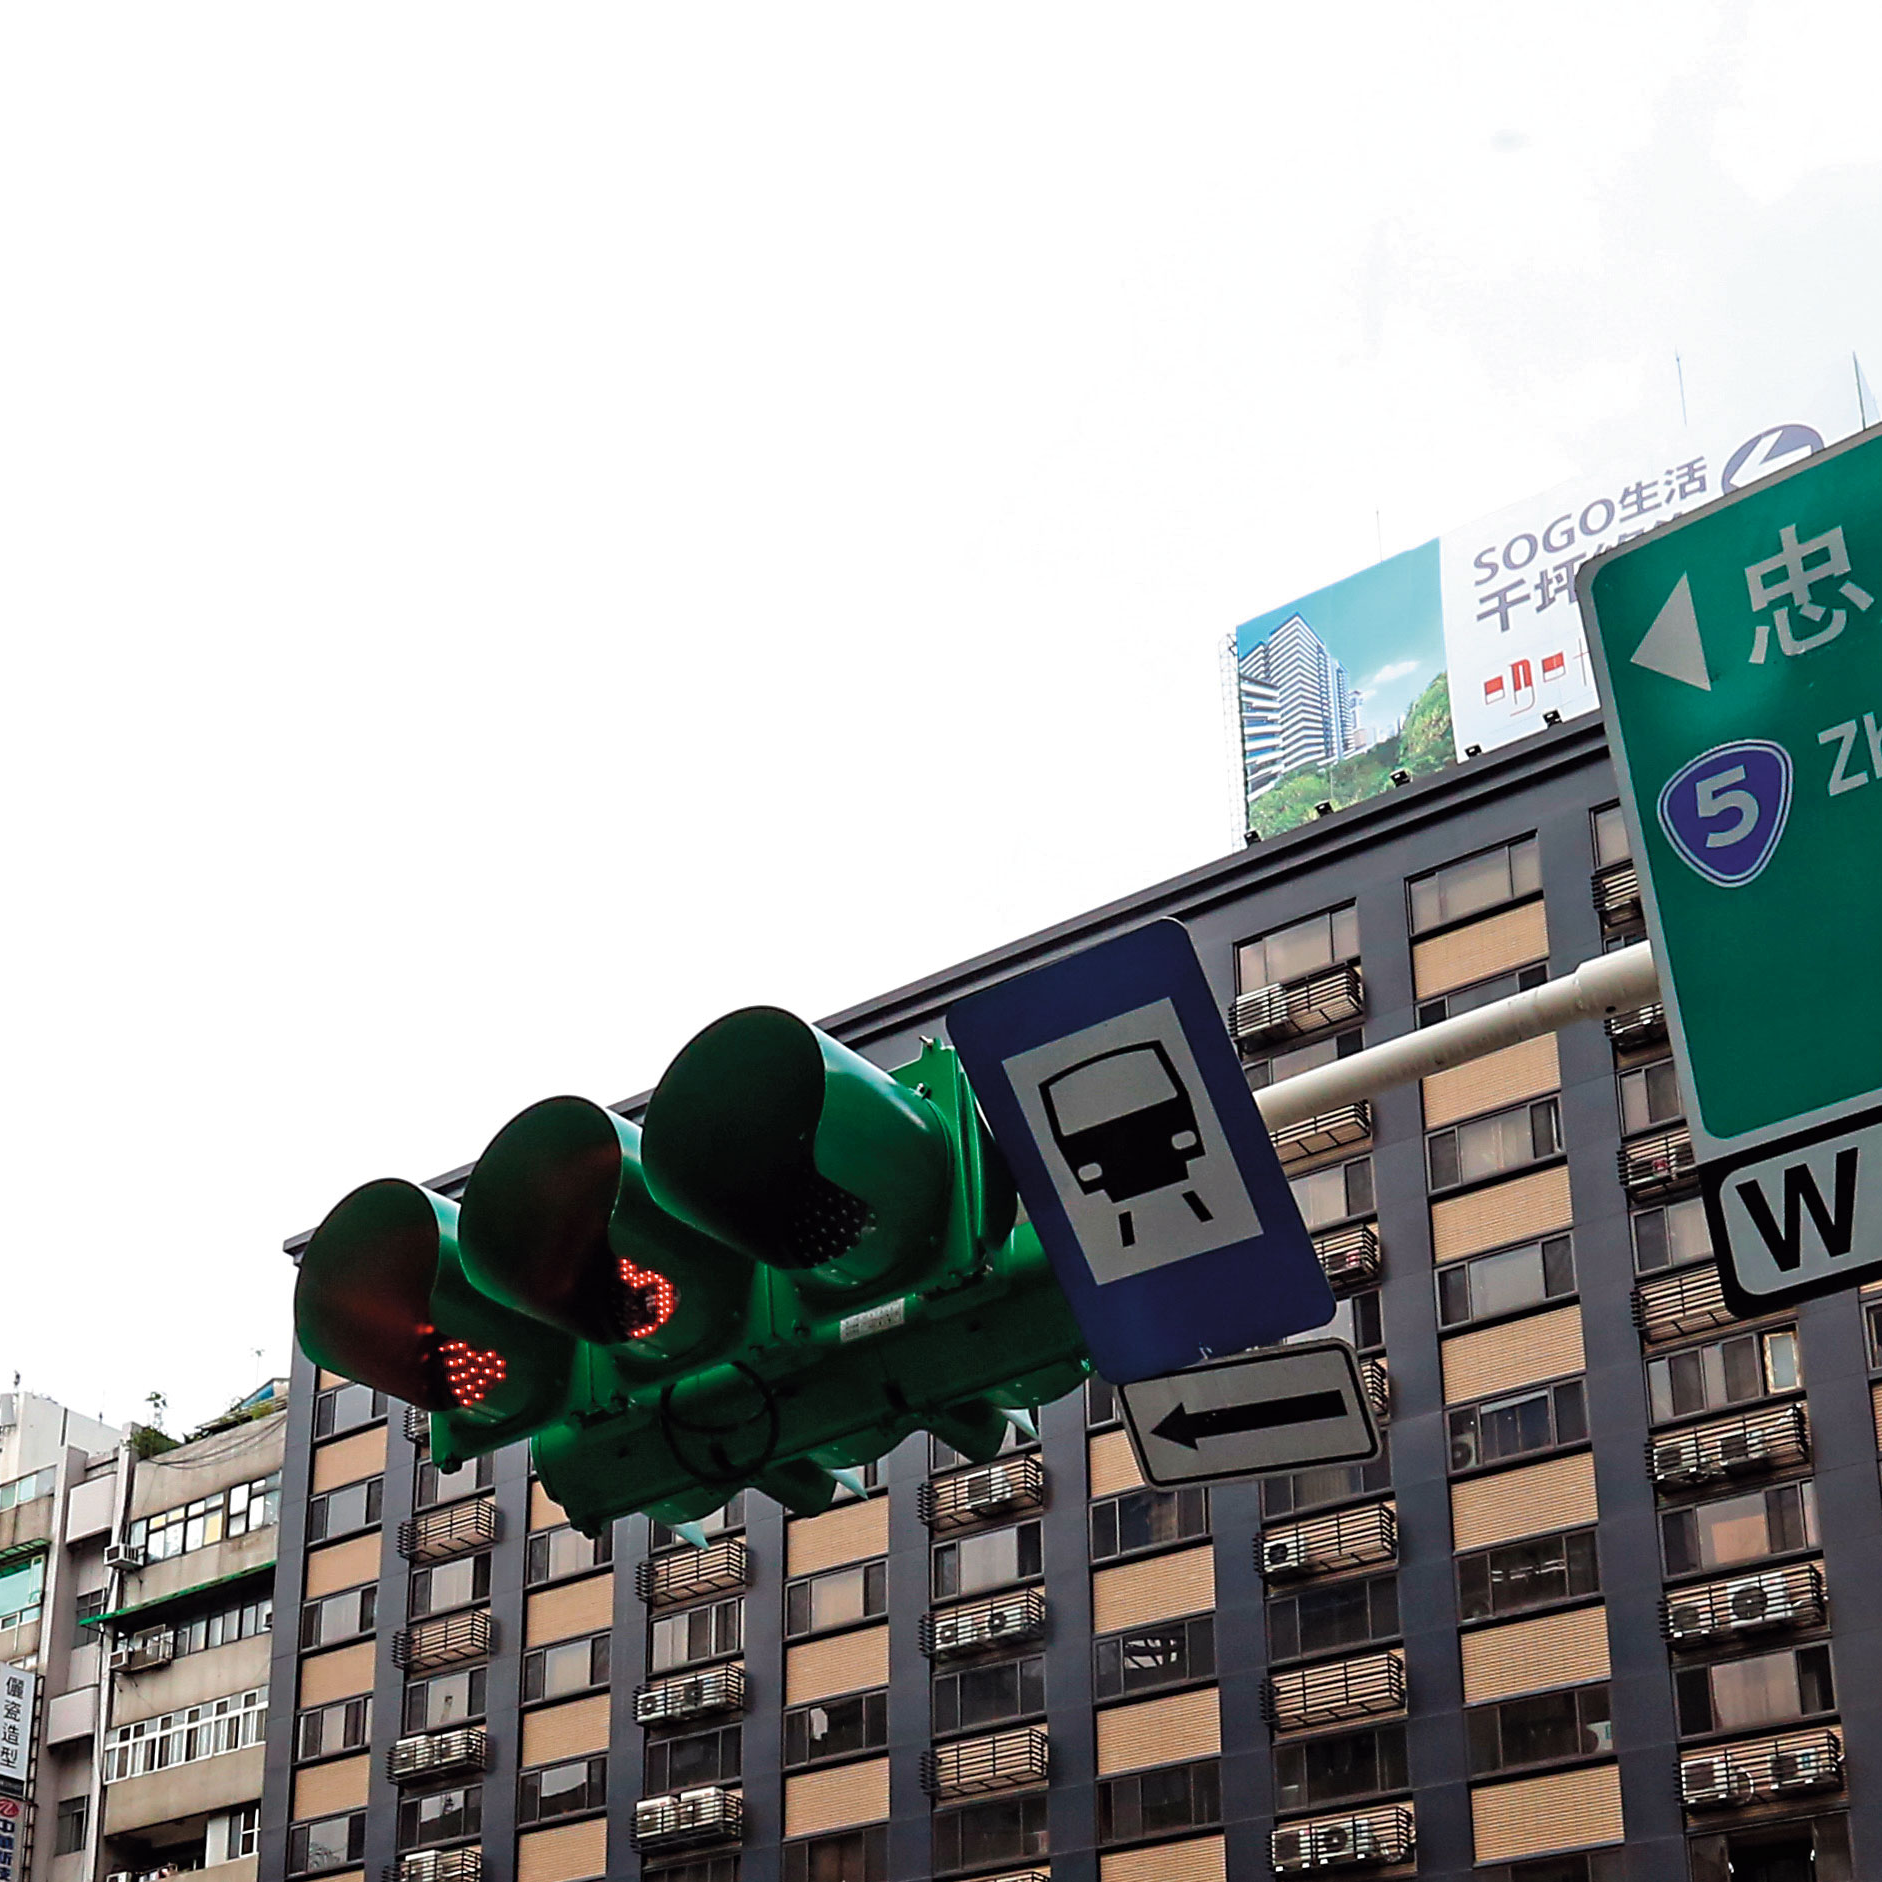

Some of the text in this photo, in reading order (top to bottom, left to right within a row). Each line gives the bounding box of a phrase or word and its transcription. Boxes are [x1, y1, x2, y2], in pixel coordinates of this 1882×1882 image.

[1473, 456, 1708, 587] SOGO生活
[1692, 765, 1760, 848] 5
[1735, 1147, 1859, 1274] W
[0, 1677, 25, 1769] 儷瓷造型
